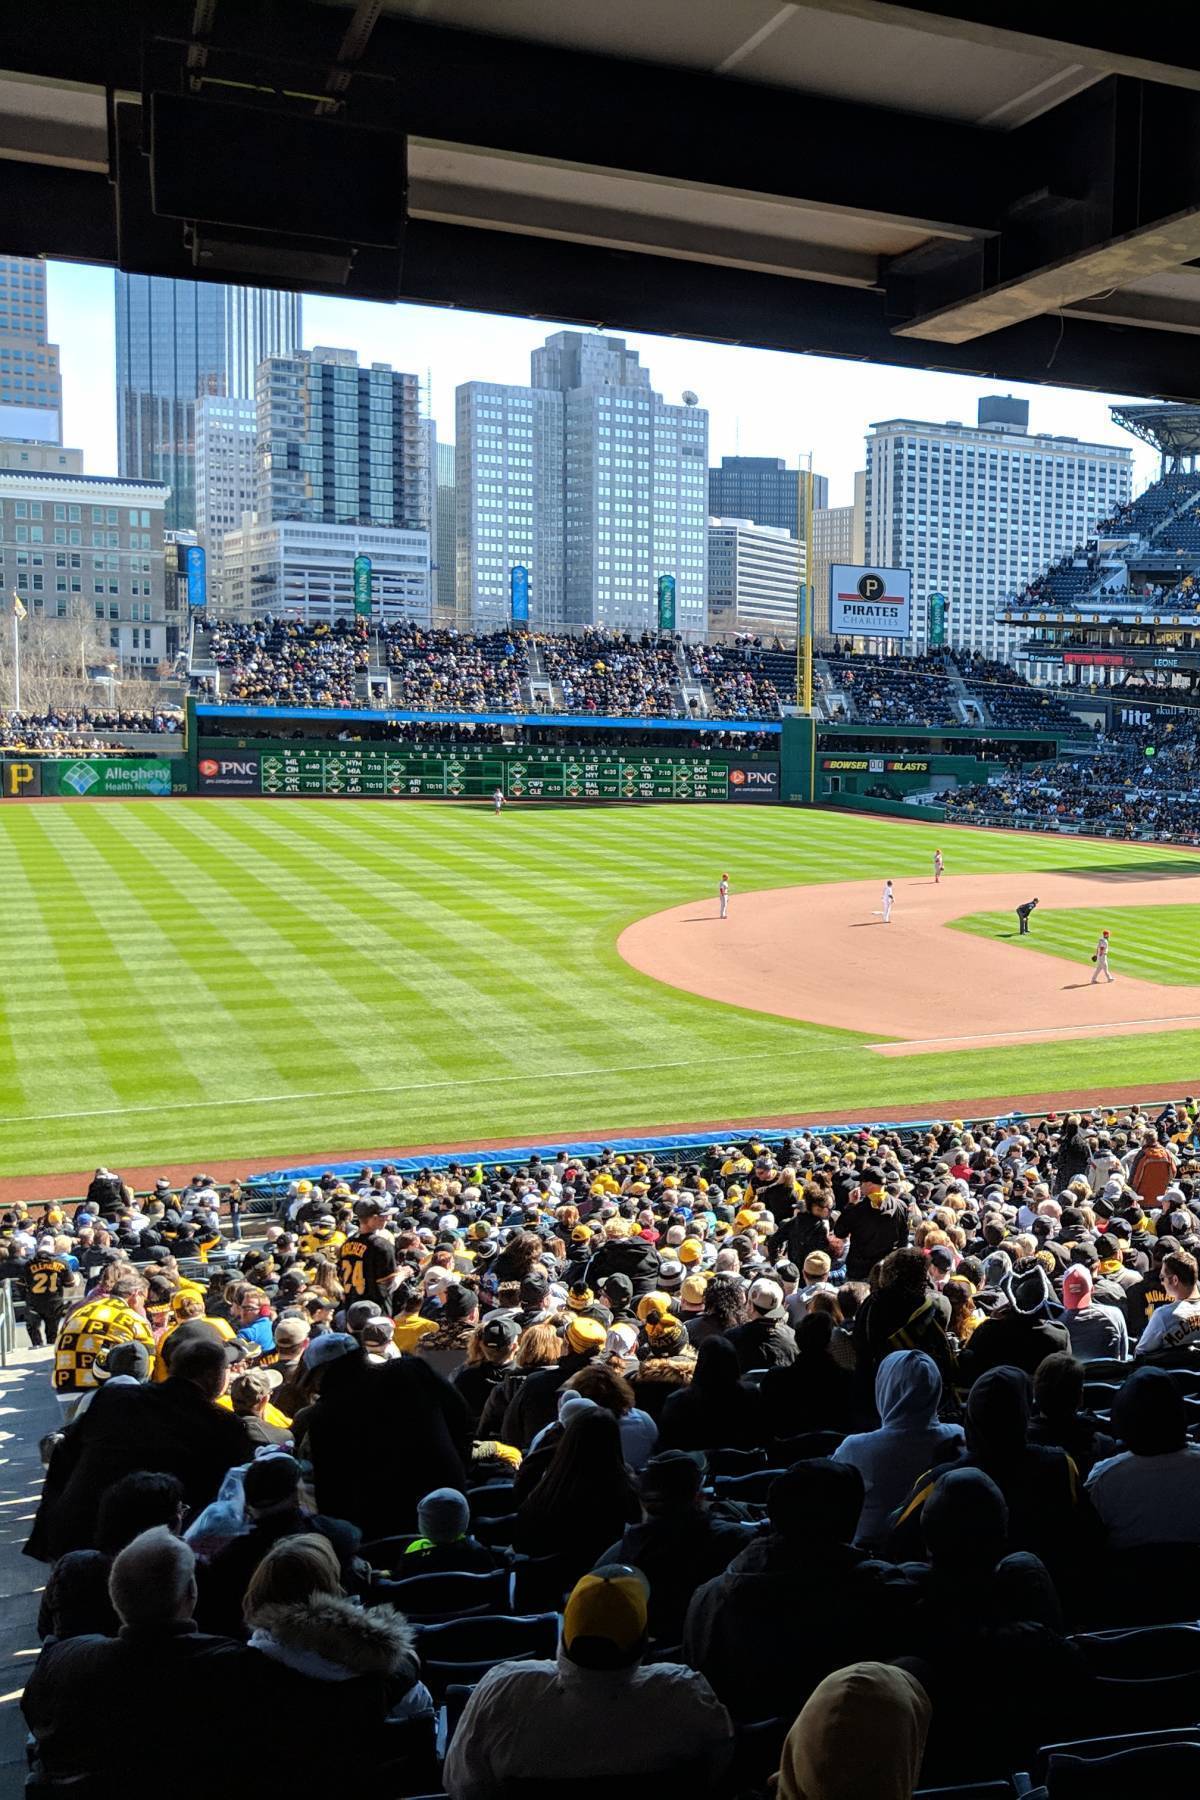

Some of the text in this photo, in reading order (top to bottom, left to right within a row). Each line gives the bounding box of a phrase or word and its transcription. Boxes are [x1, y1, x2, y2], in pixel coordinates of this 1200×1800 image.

[866, 580, 878, 596] P
[843, 604, 898, 617] PIRATES
[843, 616, 898, 626] CHARITIES
[1154, 659, 1178, 667] LEONE
[1121, 709, 1151, 725] lite
[284, 750, 390, 758] NATIONAL
[528, 755, 625, 763] AMERICAN
[222, 762, 257, 775] PNC
[830, 761, 868, 769] BOWSER
[893, 763, 927, 771] BLASTS
[10, 764, 34, 794] P
[105, 768, 170, 785] Allegheny
[747, 772, 777, 784] PNC
[106, 783, 133, 791] Health
[32, 1273, 58, 1294] 21
[62, 1335, 73, 1349] P
[82, 1355, 93, 1367] P
[59, 1371, 70, 1385] P
